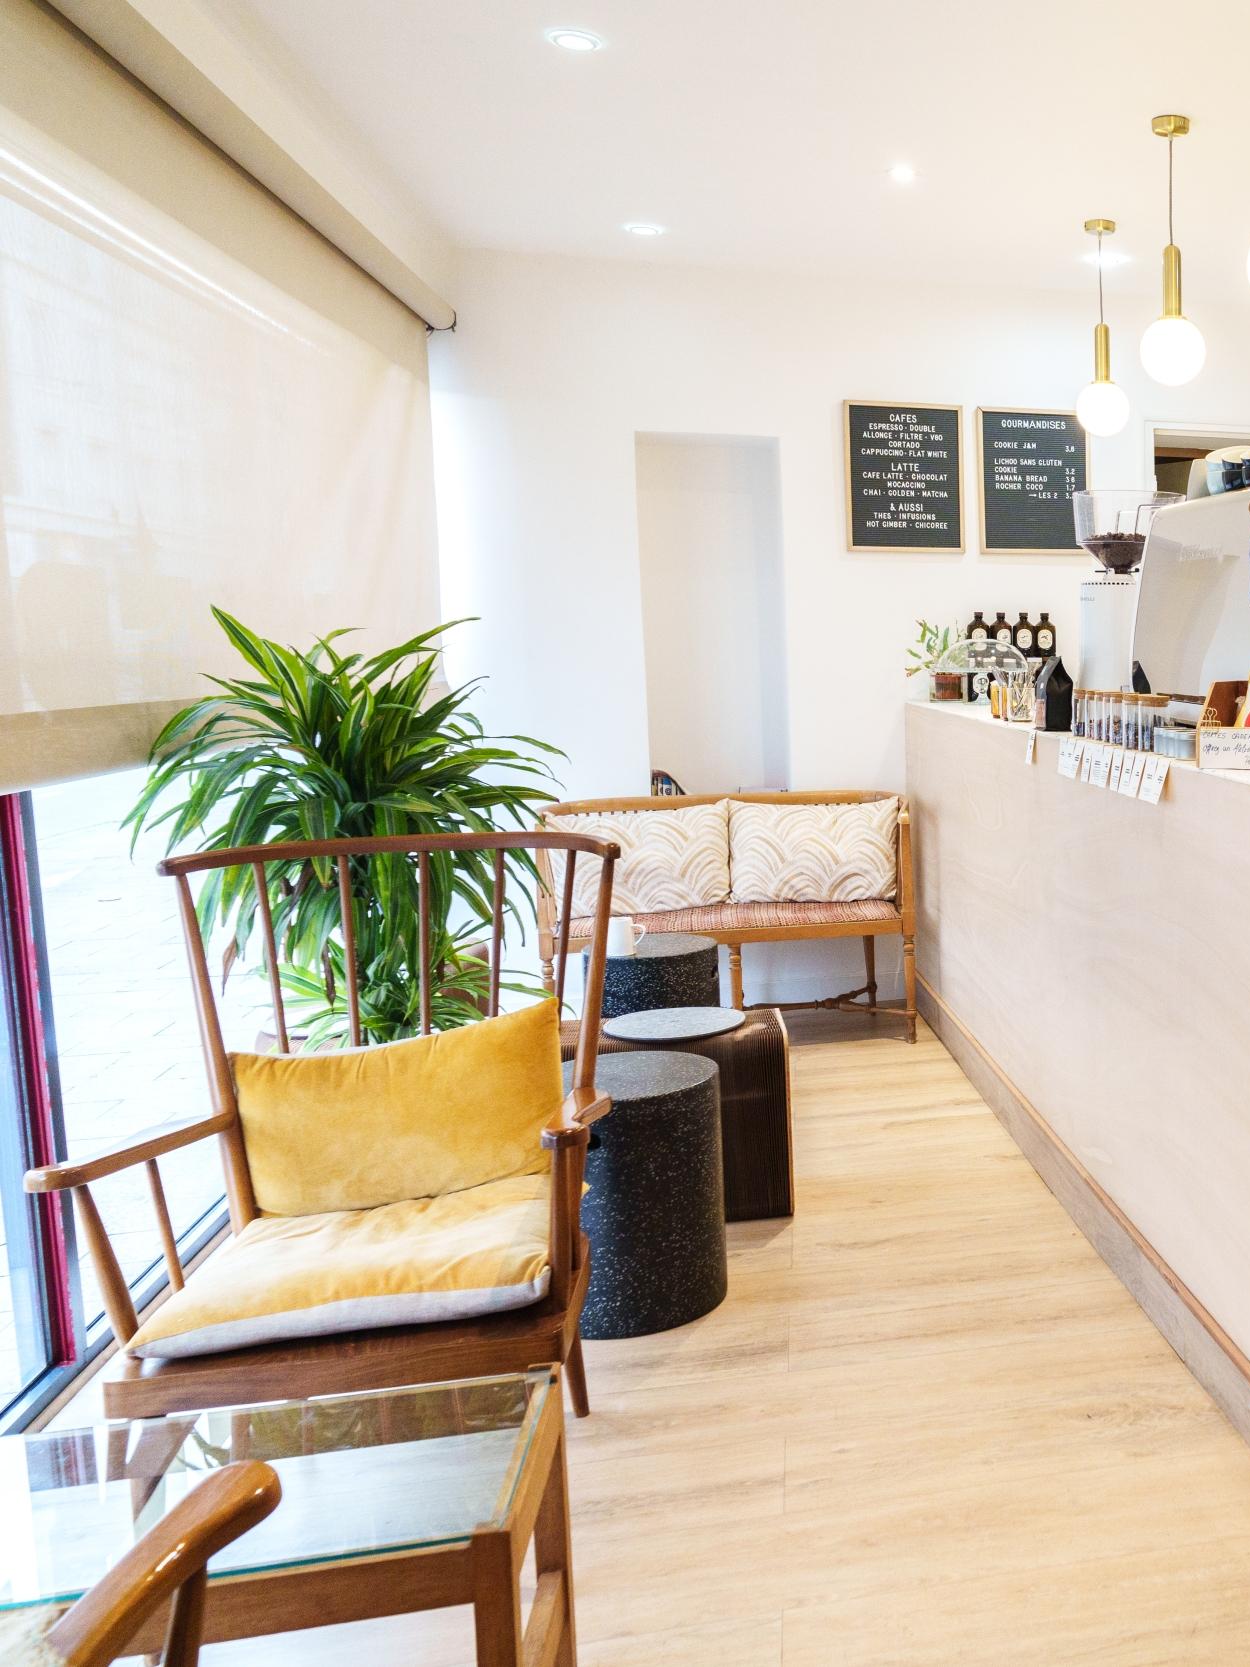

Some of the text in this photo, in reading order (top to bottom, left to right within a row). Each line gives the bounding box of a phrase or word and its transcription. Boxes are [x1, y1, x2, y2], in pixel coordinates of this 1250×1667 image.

[889, 414, 917, 423] CAFES
[910, 425, 936, 433] DOUBLE
[1001, 420, 1066, 430] GOURMANDISES
[891, 463, 920, 472] LATTE
[890, 503, 923, 512] & AUSSI
